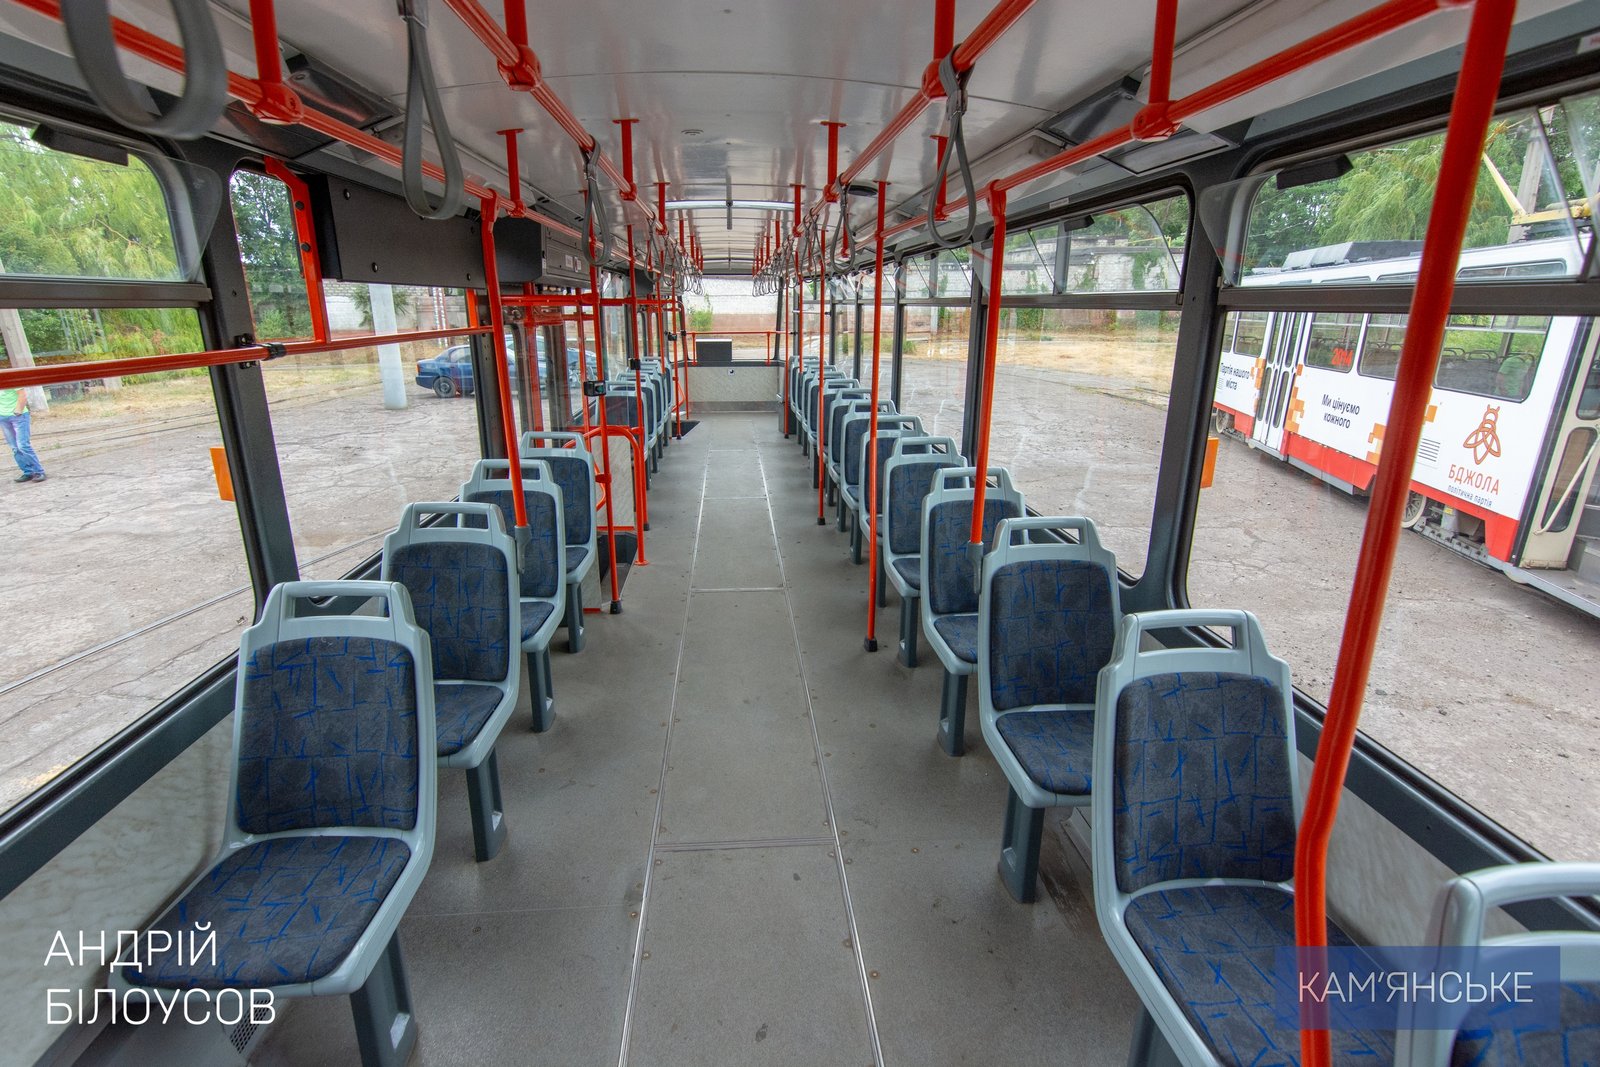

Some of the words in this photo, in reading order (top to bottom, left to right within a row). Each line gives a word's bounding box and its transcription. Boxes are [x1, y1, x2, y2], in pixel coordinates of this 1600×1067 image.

[1233, 367, 1250, 380] нашого
[1321, 394, 1331, 406] Ми
[1332, 397, 1360, 415] цінуємо
[1324, 413, 1350, 428] кожного
[1448, 464, 1500, 495] БДЖОЛА
[1448, 485, 1473, 500] політична
[1474, 494, 1492, 507] партія
